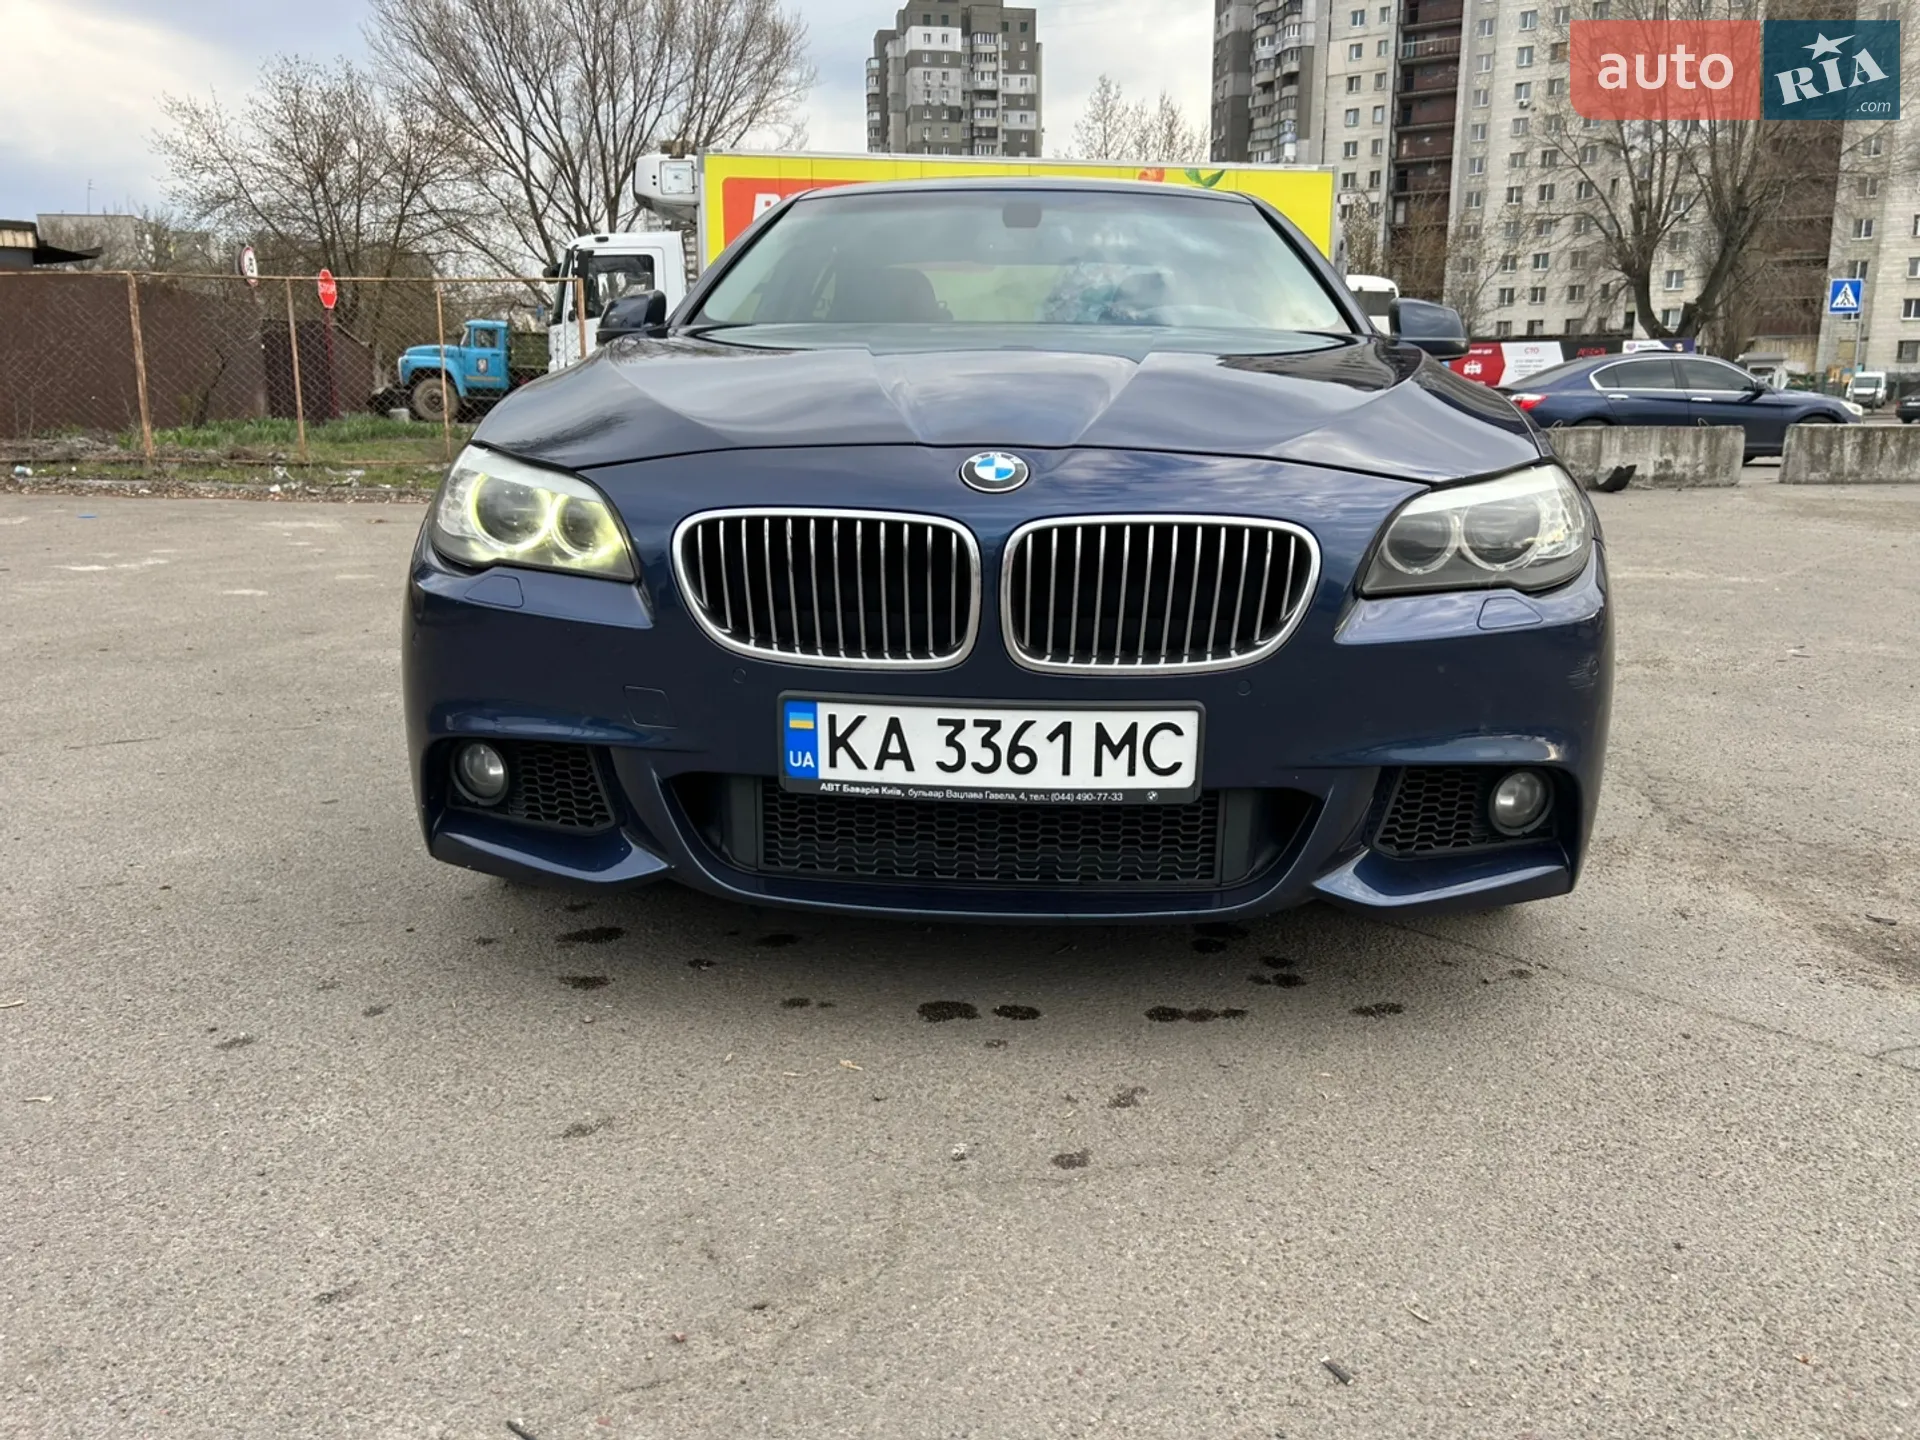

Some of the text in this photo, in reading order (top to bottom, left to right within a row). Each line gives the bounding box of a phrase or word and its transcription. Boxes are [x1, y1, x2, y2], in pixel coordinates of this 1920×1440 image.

[827, 713, 1184, 777] KA 3361 MC
[789, 750, 815, 768] UA
[820, 782, 841, 792] АВТ
[842, 784, 880, 796] Баварія
[881, 786, 905, 797] Київ,
[908, 788, 944, 798] бульвар
[945, 789, 984, 800] Вацлава
[985, 790, 1018, 801] Гавела,
[1019, 791, 1028, 801] 4,
[1050, 792, 1075, 802] (044)
[1076, 792, 1124, 802] 490-77-33
